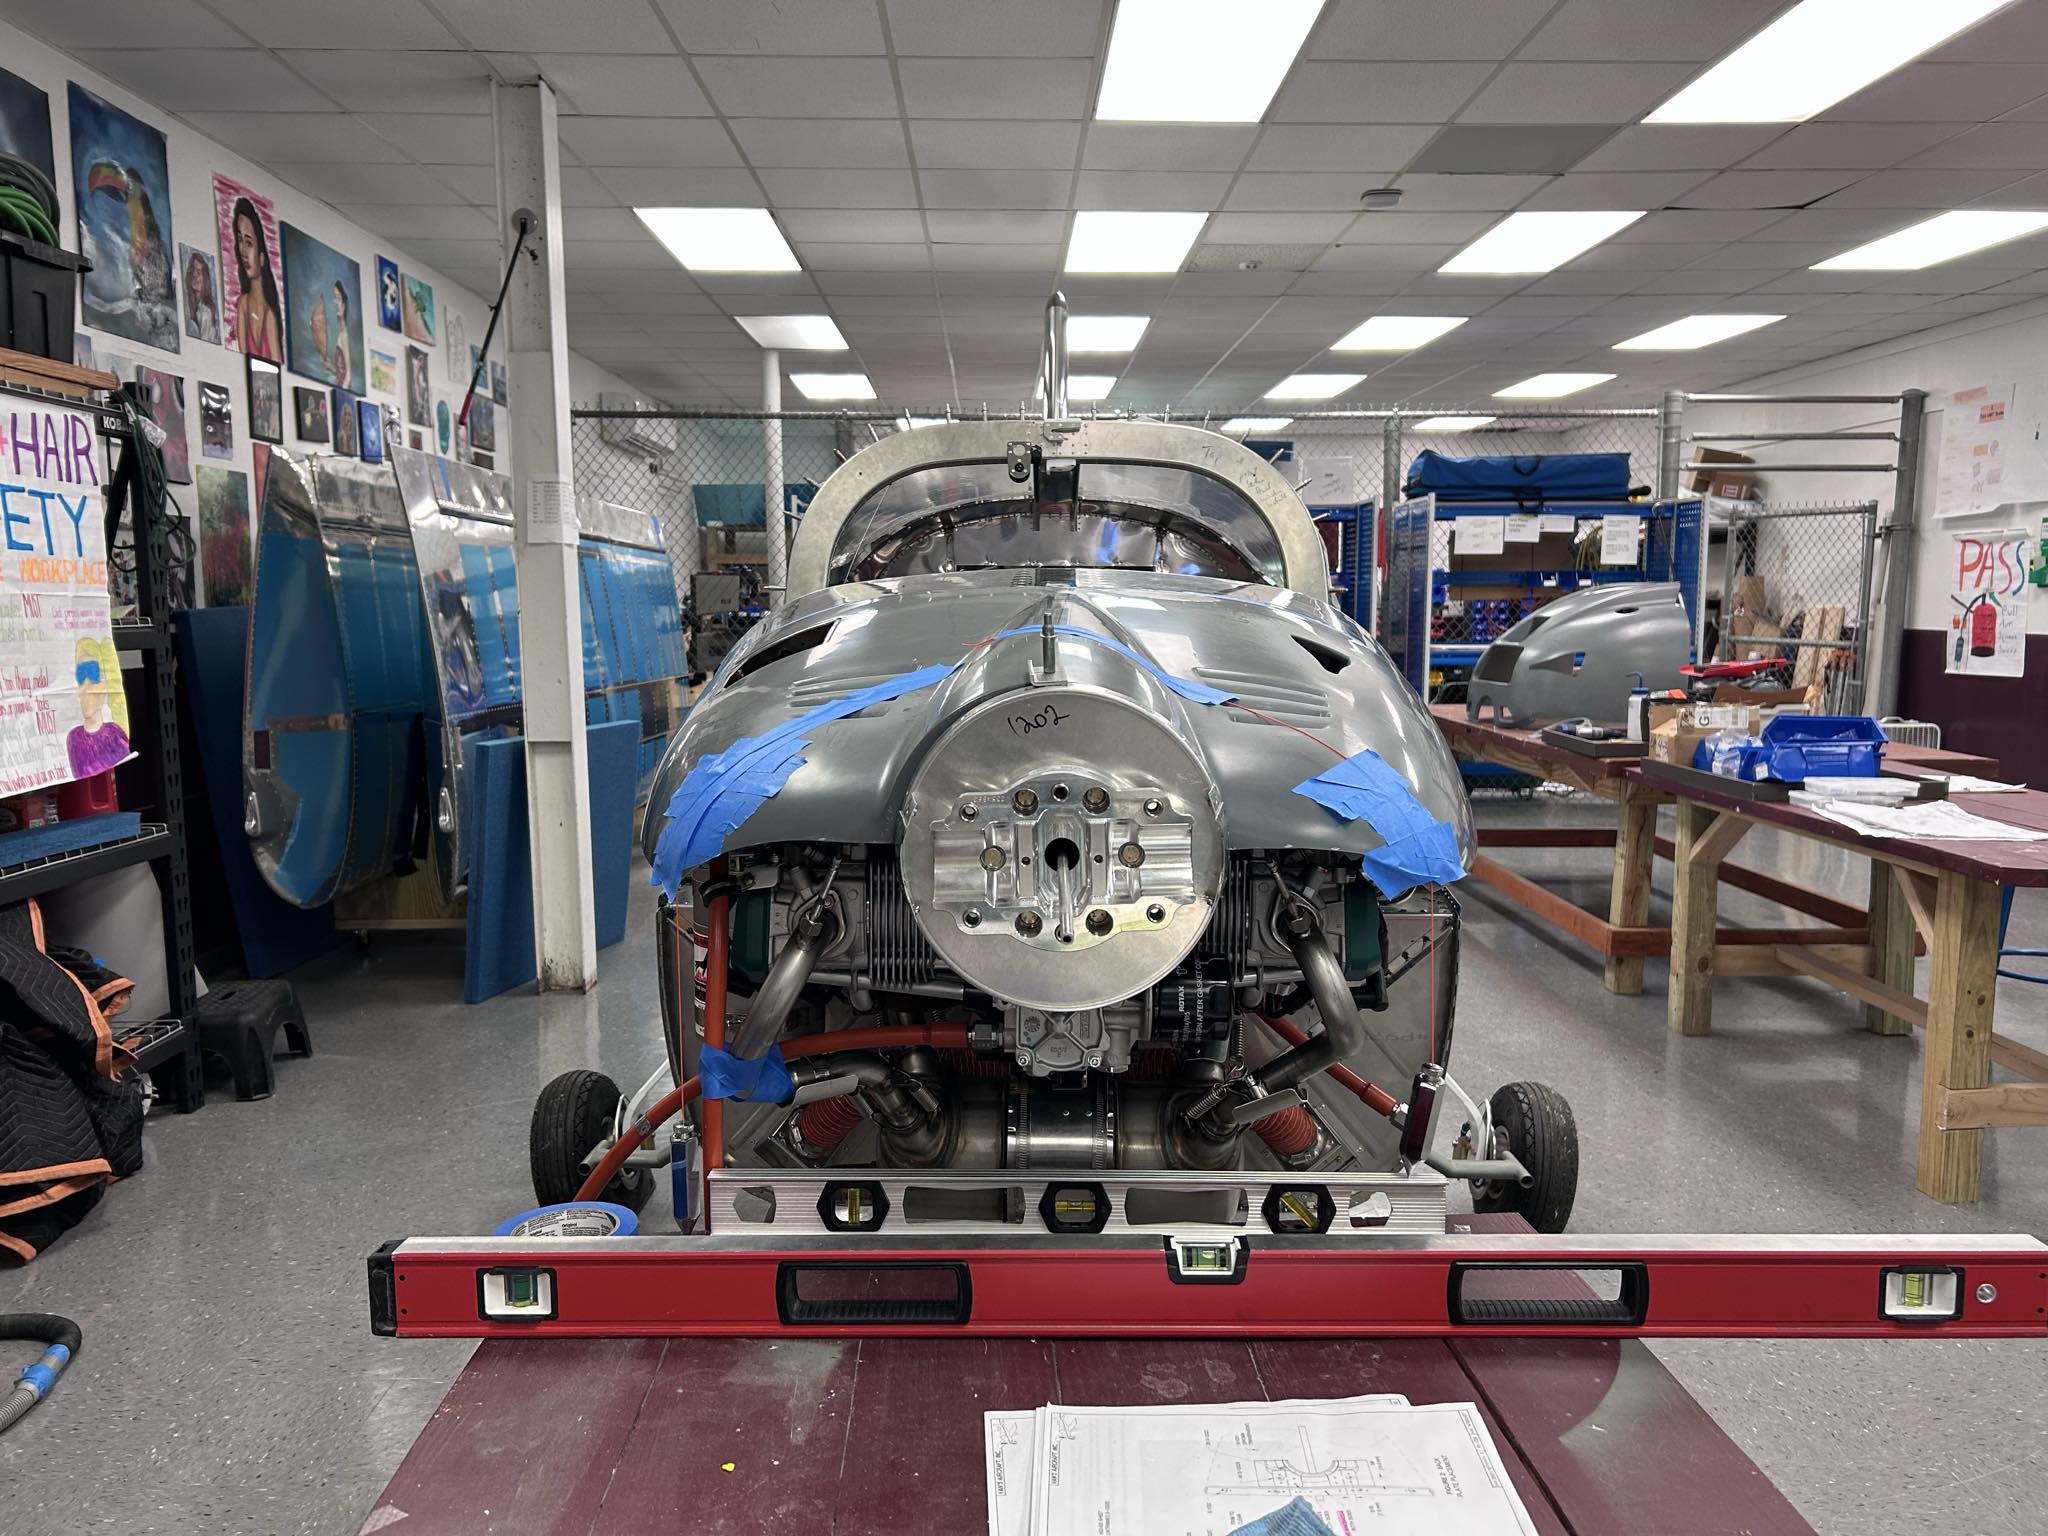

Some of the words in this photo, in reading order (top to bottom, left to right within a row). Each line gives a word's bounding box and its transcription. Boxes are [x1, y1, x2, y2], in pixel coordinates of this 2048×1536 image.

[11, 412, 99, 487] HAIR
[18, 557, 107, 585] WORKPLACE
[1958, 539, 2025, 597] PASS
[2001, 604, 2018, 617] Pull
[1007, 704, 1071, 739] 1202
[1195, 971, 1204, 998] GASKET
[1196, 999, 1204, 1021] AFTER
[1434, 1458, 1443, 1470] BACK
[1441, 1455, 1456, 1481] PLACEMENT
[1440, 1477, 1452, 1495] FIGURE
[1452, 1482, 1463, 1498] PLATE
